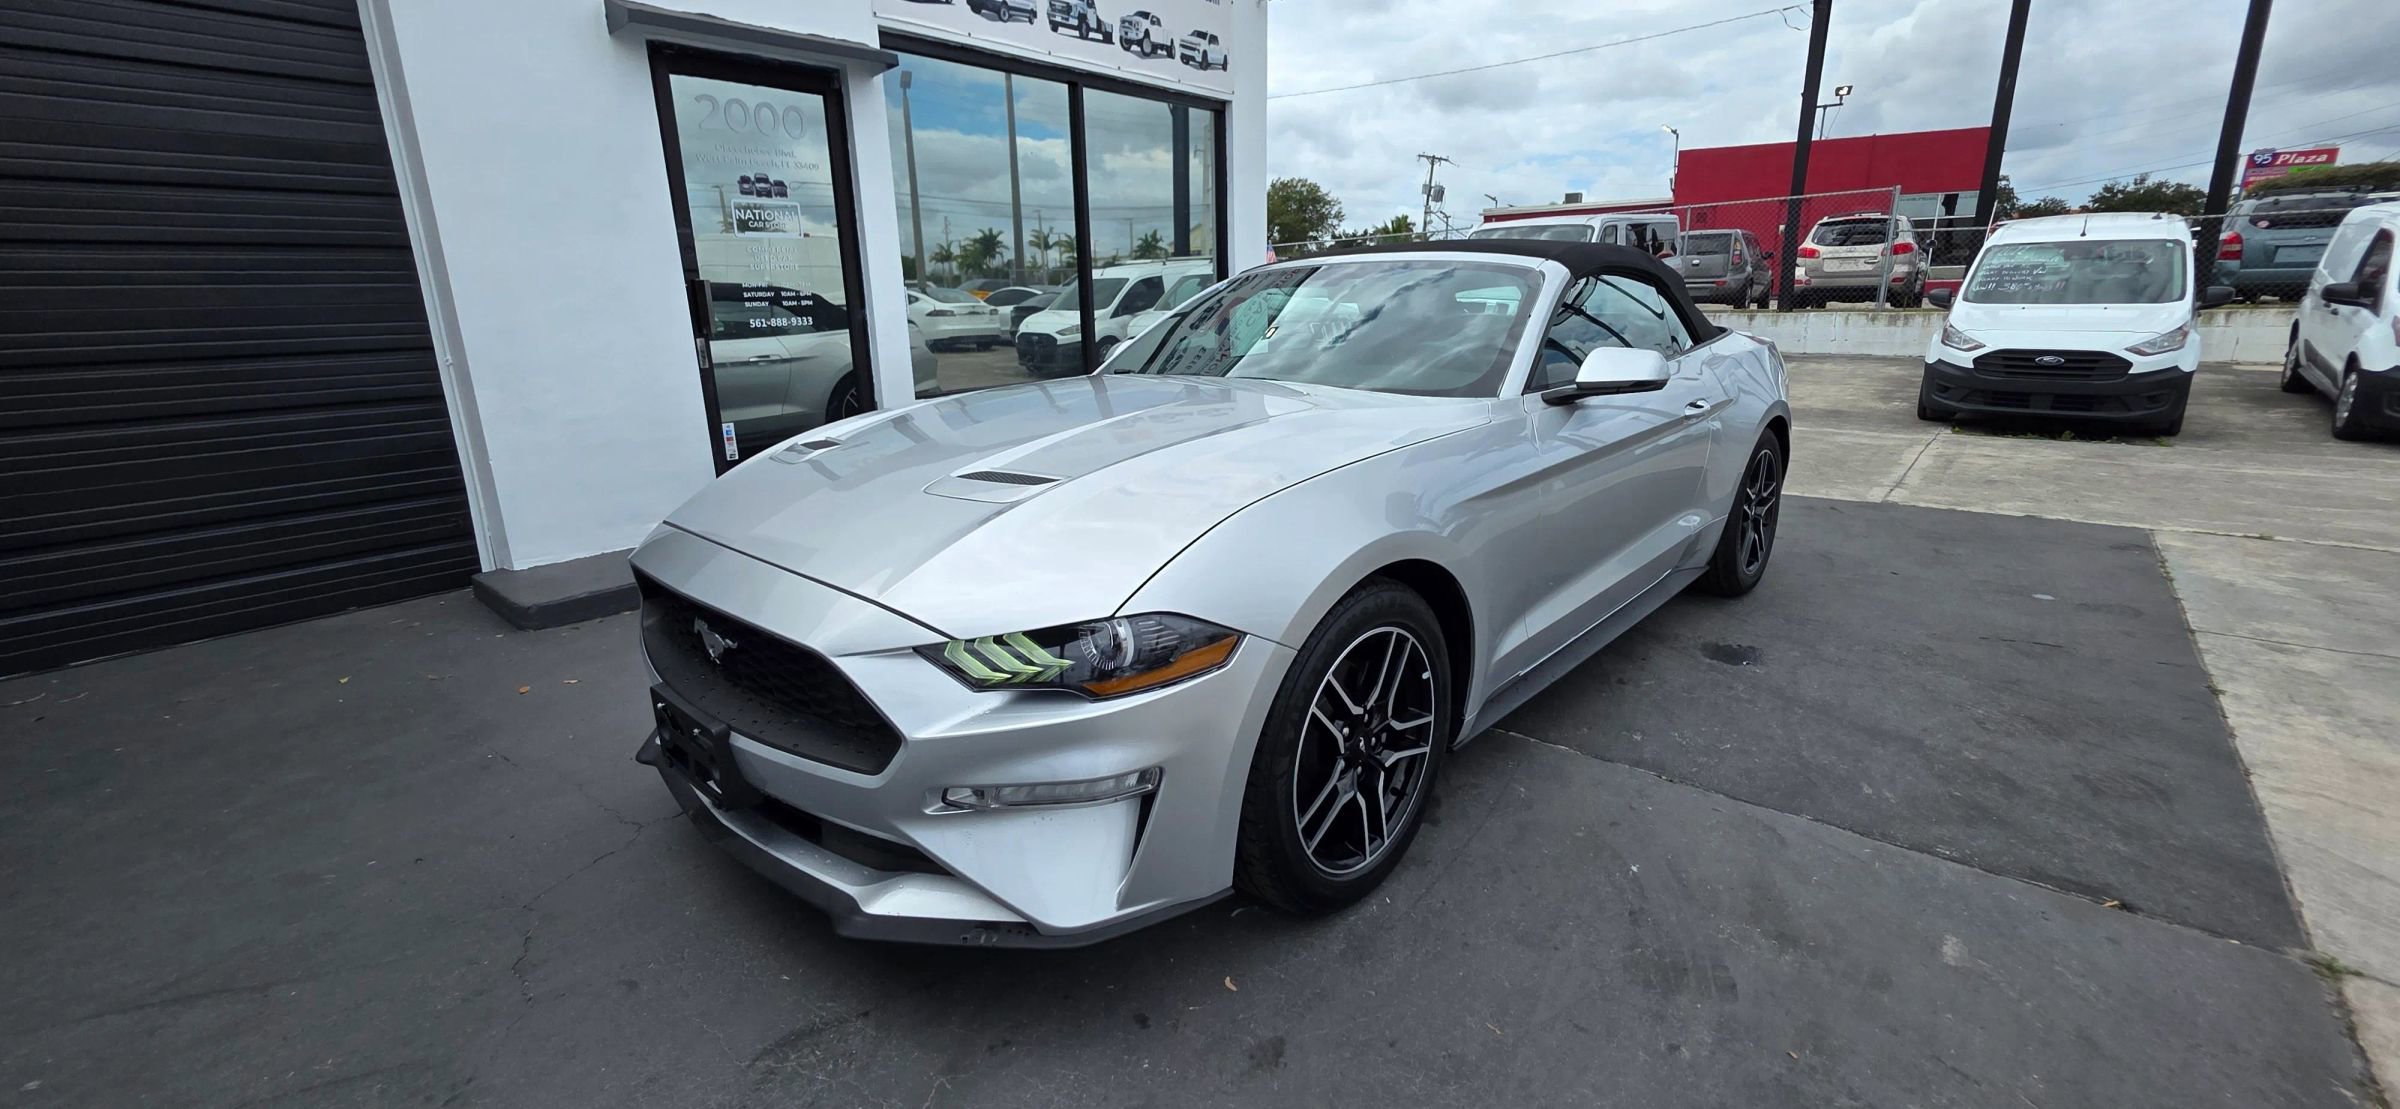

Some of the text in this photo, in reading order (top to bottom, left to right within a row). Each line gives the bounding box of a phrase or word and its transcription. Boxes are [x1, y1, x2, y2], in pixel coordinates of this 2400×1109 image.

[694, 94, 808, 140] 2000
[2253, 153, 2329, 165] 95 Plaza
[735, 208, 796, 221] NATIONAL
[749, 316, 814, 328] 561-888-9333
